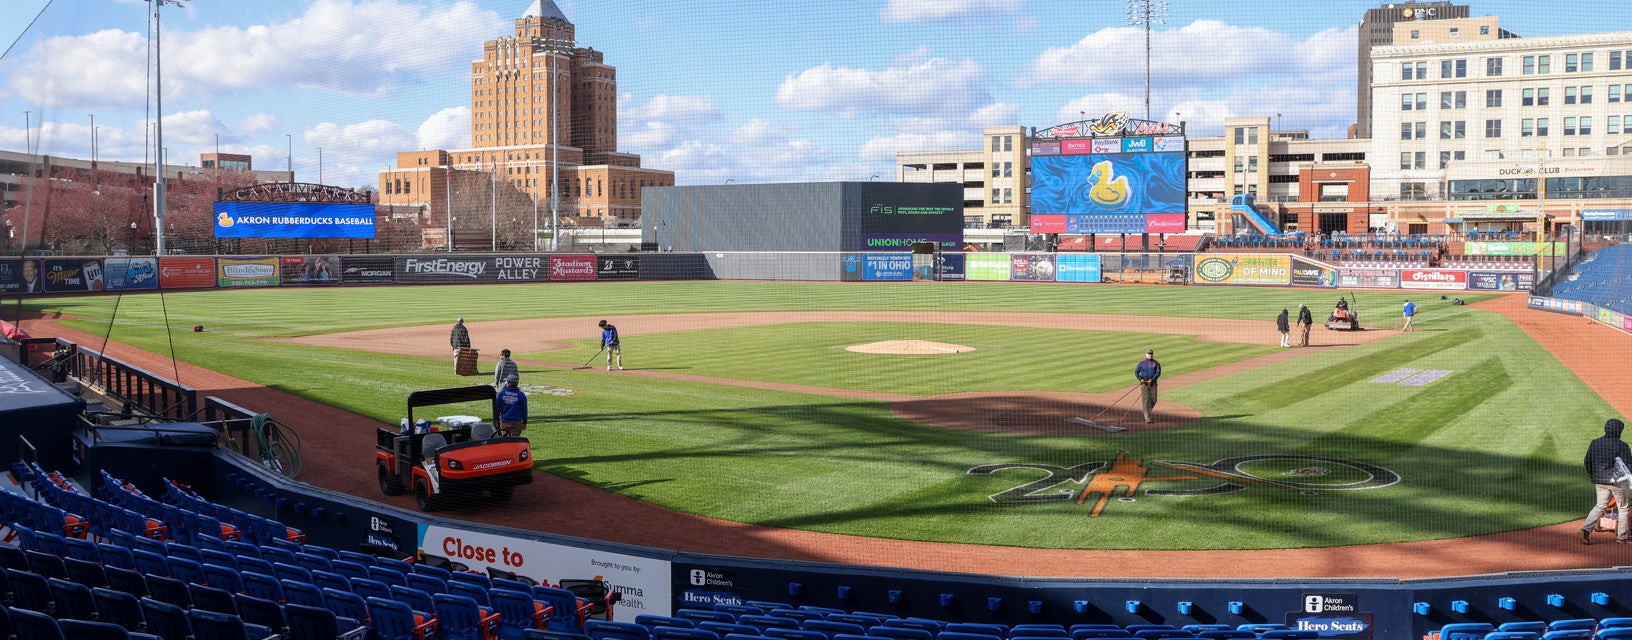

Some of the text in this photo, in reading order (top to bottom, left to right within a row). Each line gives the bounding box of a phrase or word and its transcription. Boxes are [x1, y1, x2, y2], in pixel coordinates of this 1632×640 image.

[236, 183, 353, 201] CANAL PARK
[870, 206, 892, 214] FIS
[237, 216, 270, 224] AKRON
[405, 258, 486, 275] FirstEnergy
[496, 257, 541, 268] POWER
[553, 258, 592, 268] Stadium
[879, 261, 888, 270] IN
[889, 261, 910, 270] OHIO
[48, 268, 80, 284] Miller
[497, 269, 538, 280] ALLEY
[553, 267, 594, 276] Mustard
[1412, 272, 1456, 281] distillata
[472, 460, 512, 470] JACOBSEN
[368, 535, 398, 550] Hero Seats
[442, 536, 524, 568] Close to
[591, 558, 614, 569] Brought
[706, 570, 723, 580] Akron
[706, 577, 732, 587] Children's
[603, 580, 644, 598] Summa
[685, 592, 742, 606] Hero Seats
[1298, 620, 1363, 631] Hero Seats
